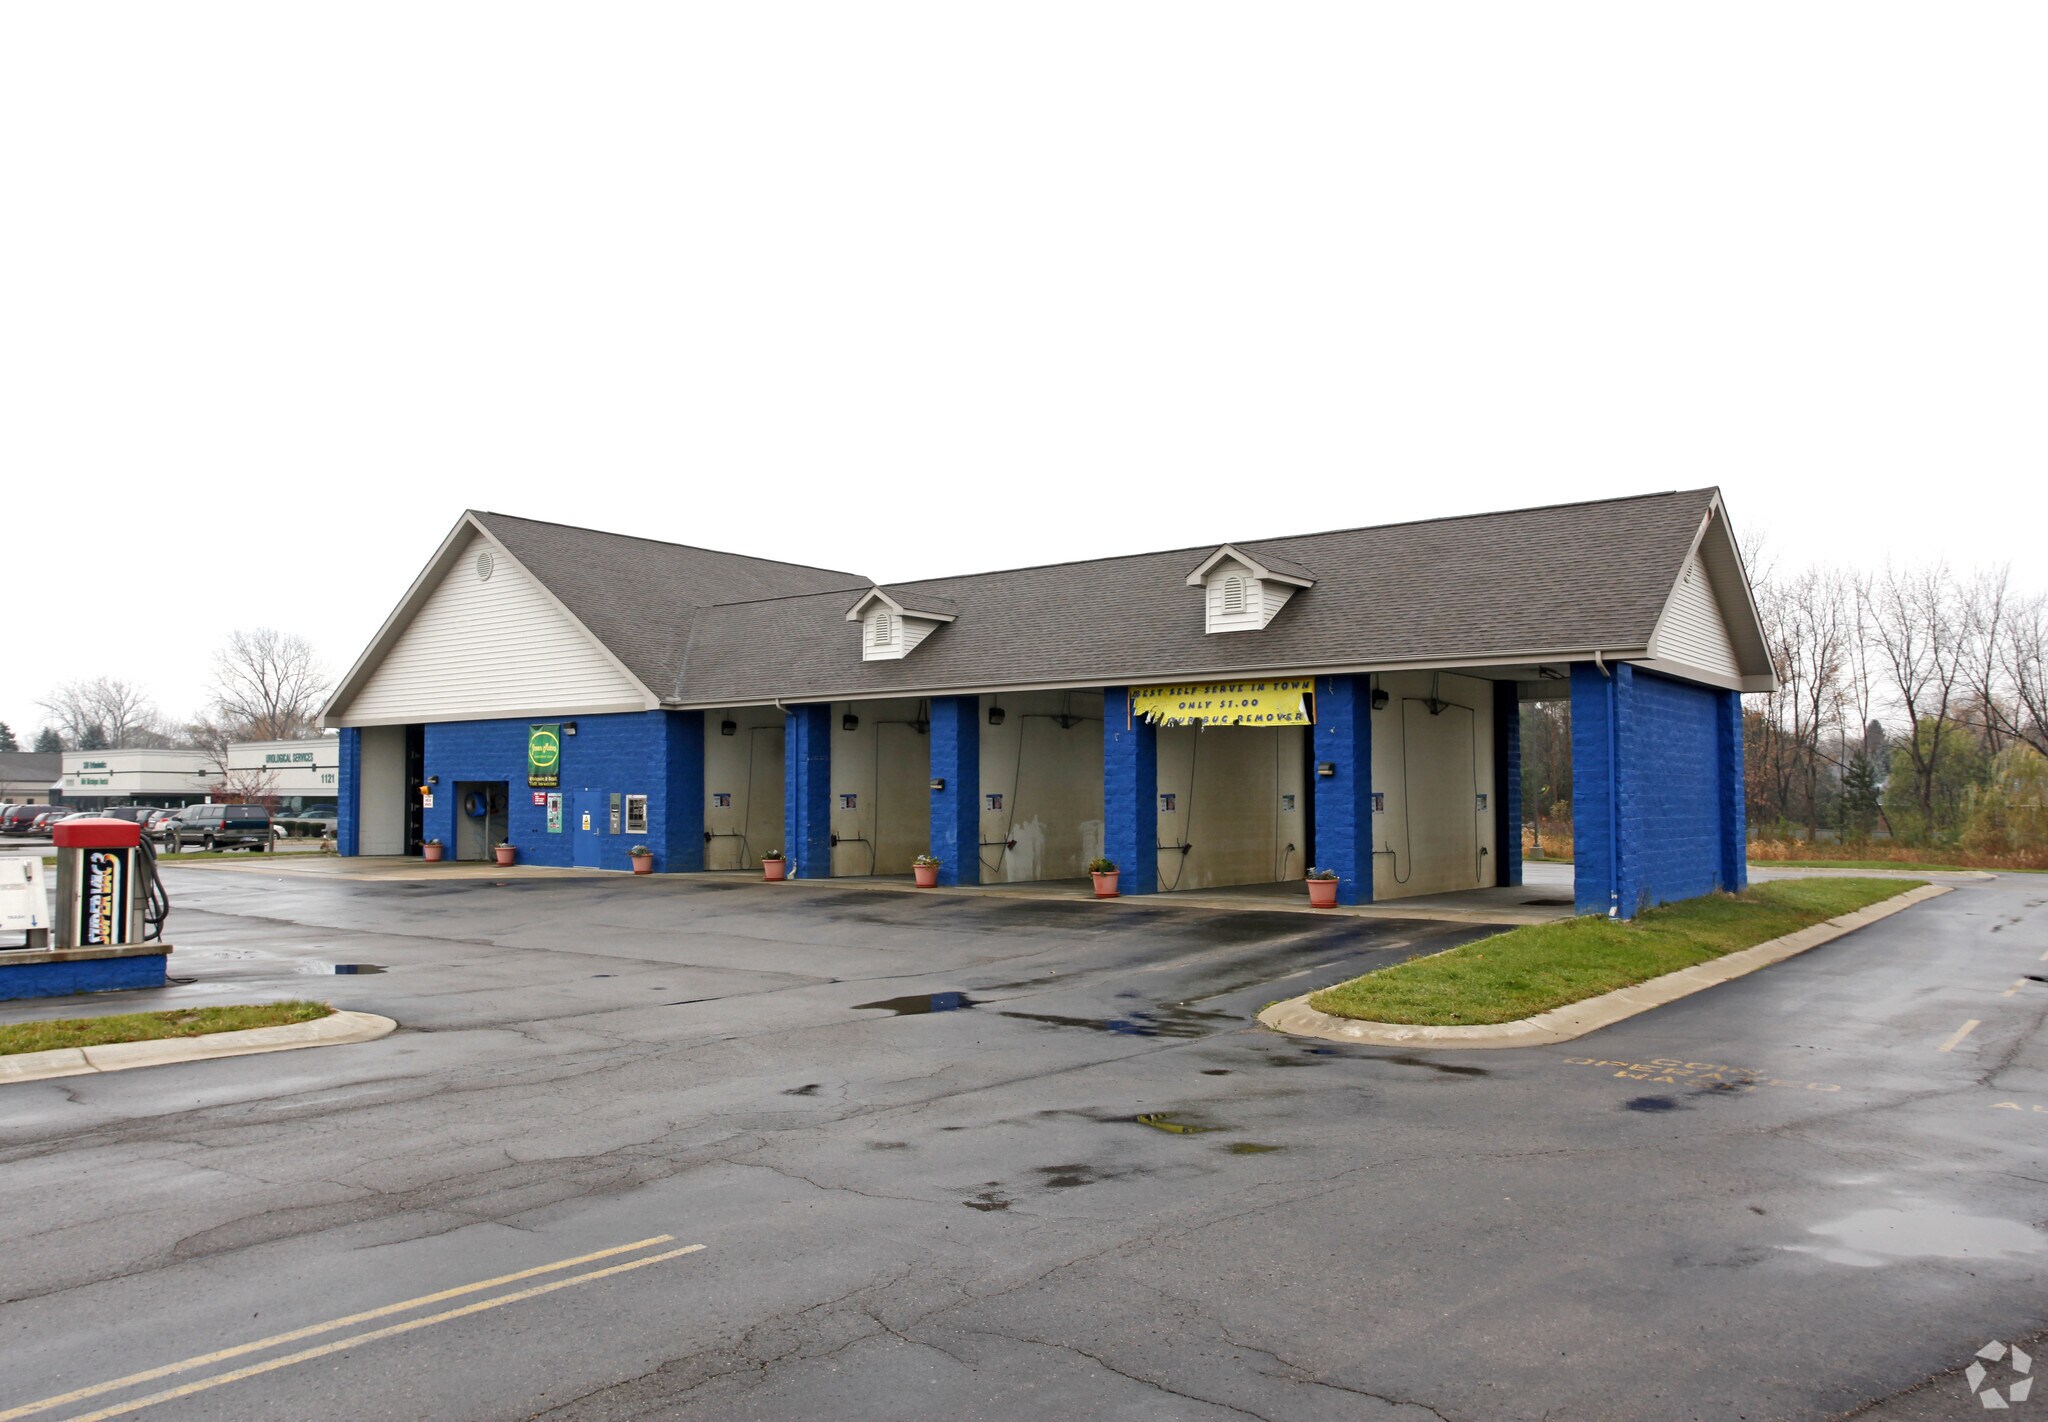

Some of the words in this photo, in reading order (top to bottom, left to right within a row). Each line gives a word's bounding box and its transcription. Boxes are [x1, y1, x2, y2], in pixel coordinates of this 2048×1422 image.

[1132, 688, 1163, 698] BEST
[1169, 686, 1198, 696] SELF
[1204, 683, 1243, 694] SERVE
[1250, 682, 1265, 692] IN
[1273, 680, 1310, 691] TOWN
[1178, 700, 1212, 710] ONLY
[1203, 715, 1228, 724] BUG
[1237, 712, 1303, 724] REMOVER
[265, 753, 292, 763] UROLOGICAL
[292, 752, 314, 763] SERVICES
[321, 773, 335, 784] 1121
